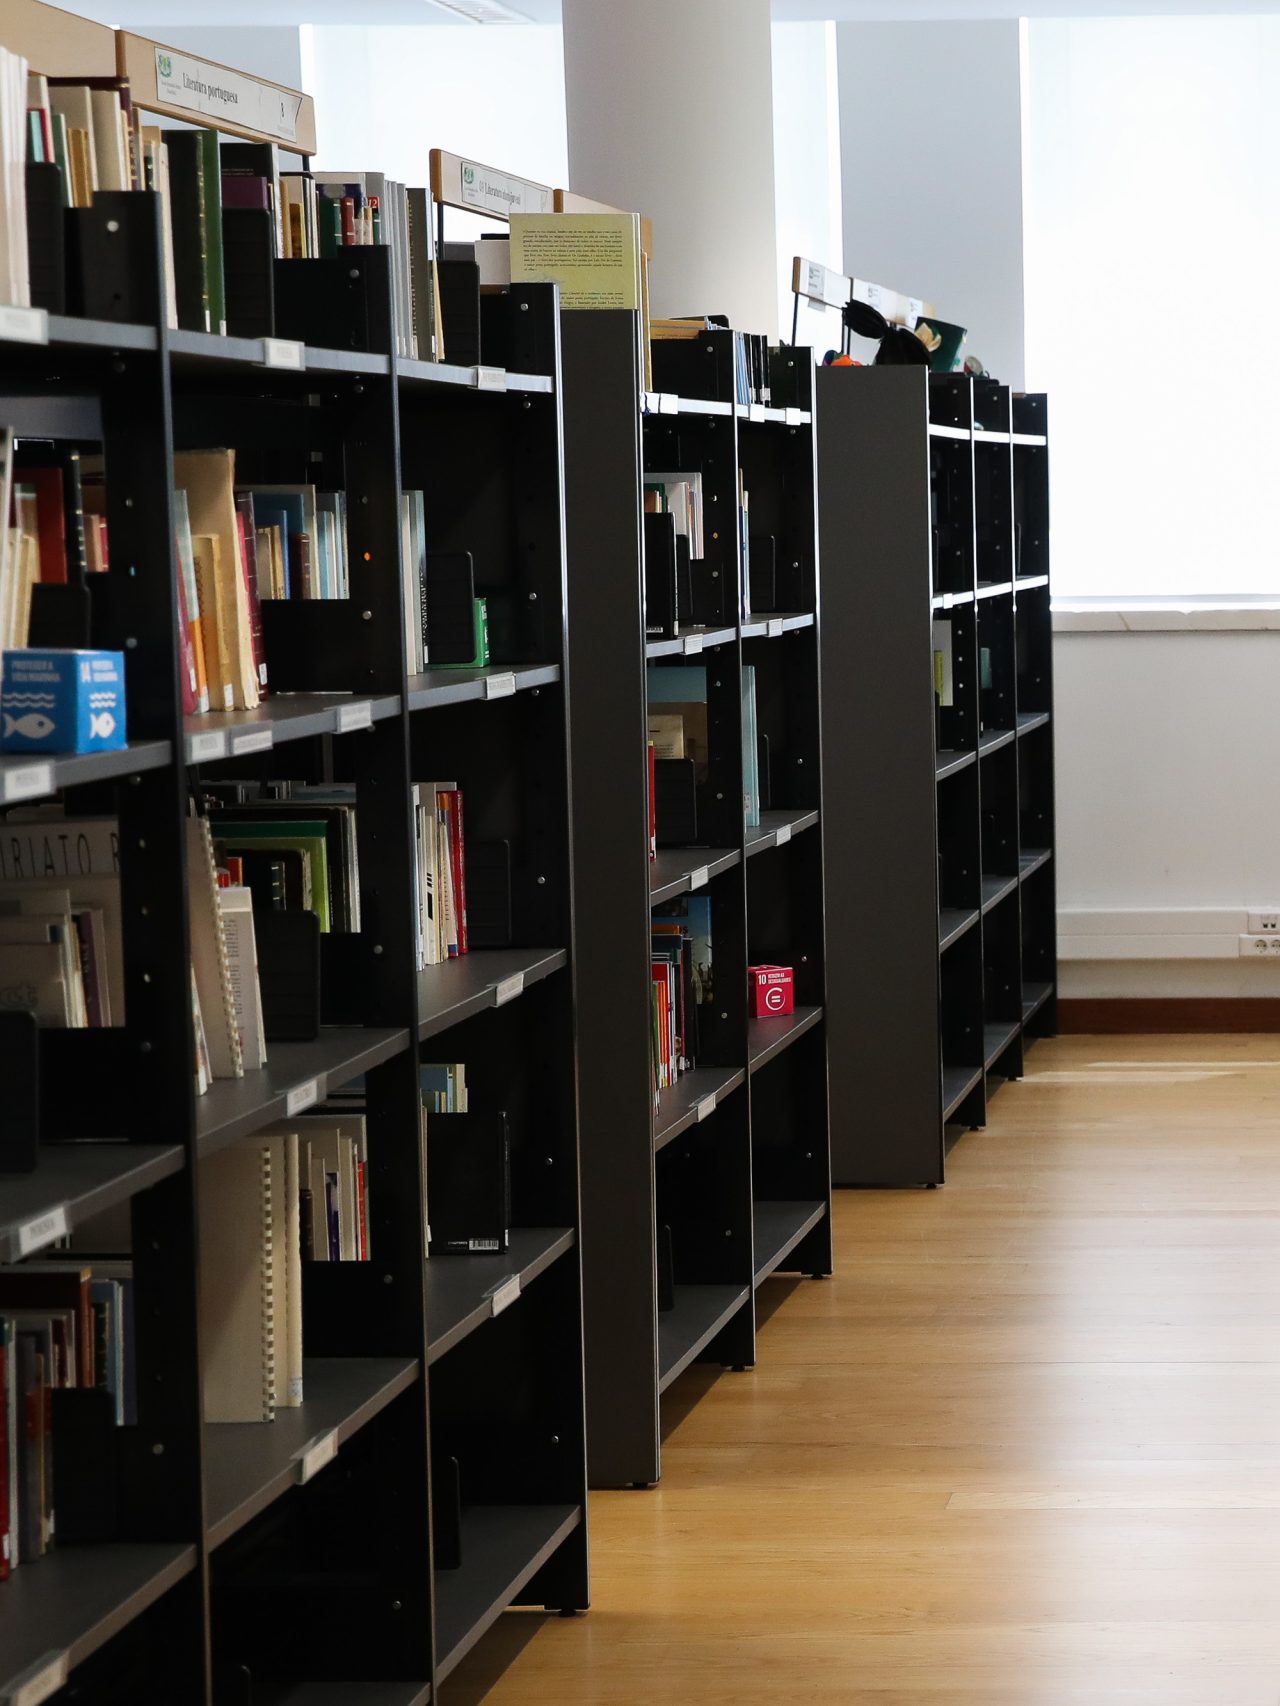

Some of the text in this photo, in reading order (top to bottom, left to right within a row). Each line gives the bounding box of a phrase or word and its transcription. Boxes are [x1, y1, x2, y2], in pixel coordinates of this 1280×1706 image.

[183, 72, 207, 95] Literatura
[208, 85, 239, 104] portuguesa
[758, 974, 766, 985] 10
